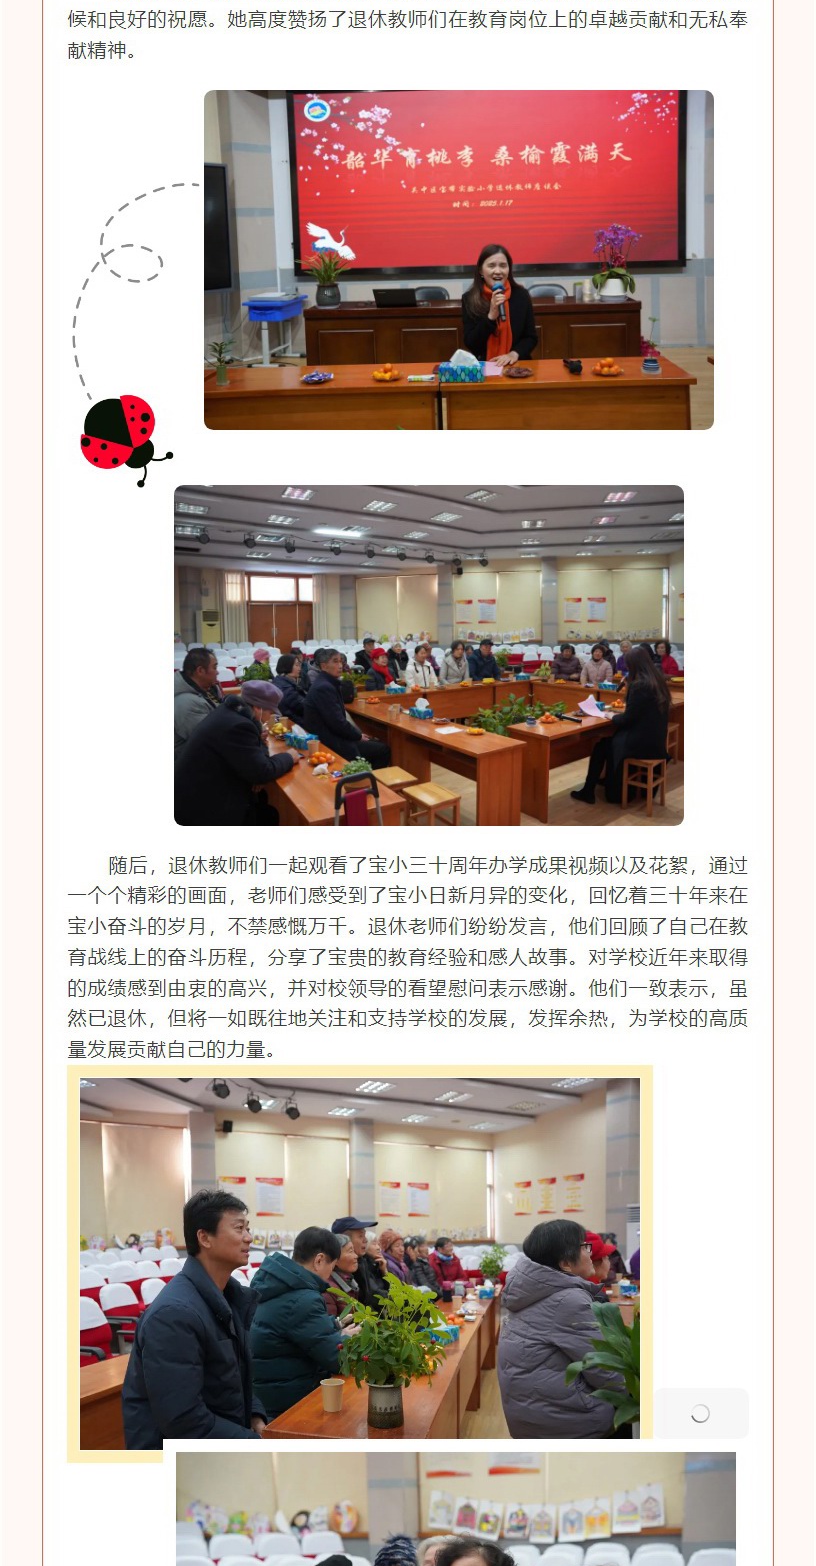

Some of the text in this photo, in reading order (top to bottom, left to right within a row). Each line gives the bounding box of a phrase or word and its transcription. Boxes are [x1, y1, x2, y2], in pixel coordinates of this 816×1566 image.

[67, 9, 748, 30] 候和良好的祝愿。她高度赞扬了退休教师们在教育岗位上的卓越贡献和无私奉
[67, 40, 136, 60] 献精神。
[489, 141, 633, 168] 桑榆霞满天
[109, 854, 748, 876] 随后，退休教师们一起观看了宝小三十周年办学成果视频以及花絮，通过
[67, 884, 749, 906] 一个个精彩的画面，老师们感受到了宝小日新月异的变化，回忆着三十年来在
[67, 915, 748, 937] 宝小奋斗的岁月，不禁感慨万千。退休老师们纷纷发言，他们回顾了自己在教
[67, 946, 749, 968] 育战线上的奋斗历程，分享了宝贵的教育经验和感人故事。对学校近年来取得
[67, 978, 748, 999] 的成绩感到由衷的高兴，并对校领导的看望慰问表示感谢。他们一致表示，虽
[67, 1007, 748, 1029] 然已退休，但将一如既往地关注和支持学校的发展，发挥余热，为学校的高质
[67, 1039, 275, 1059] 量发展贡献自己的力量。
